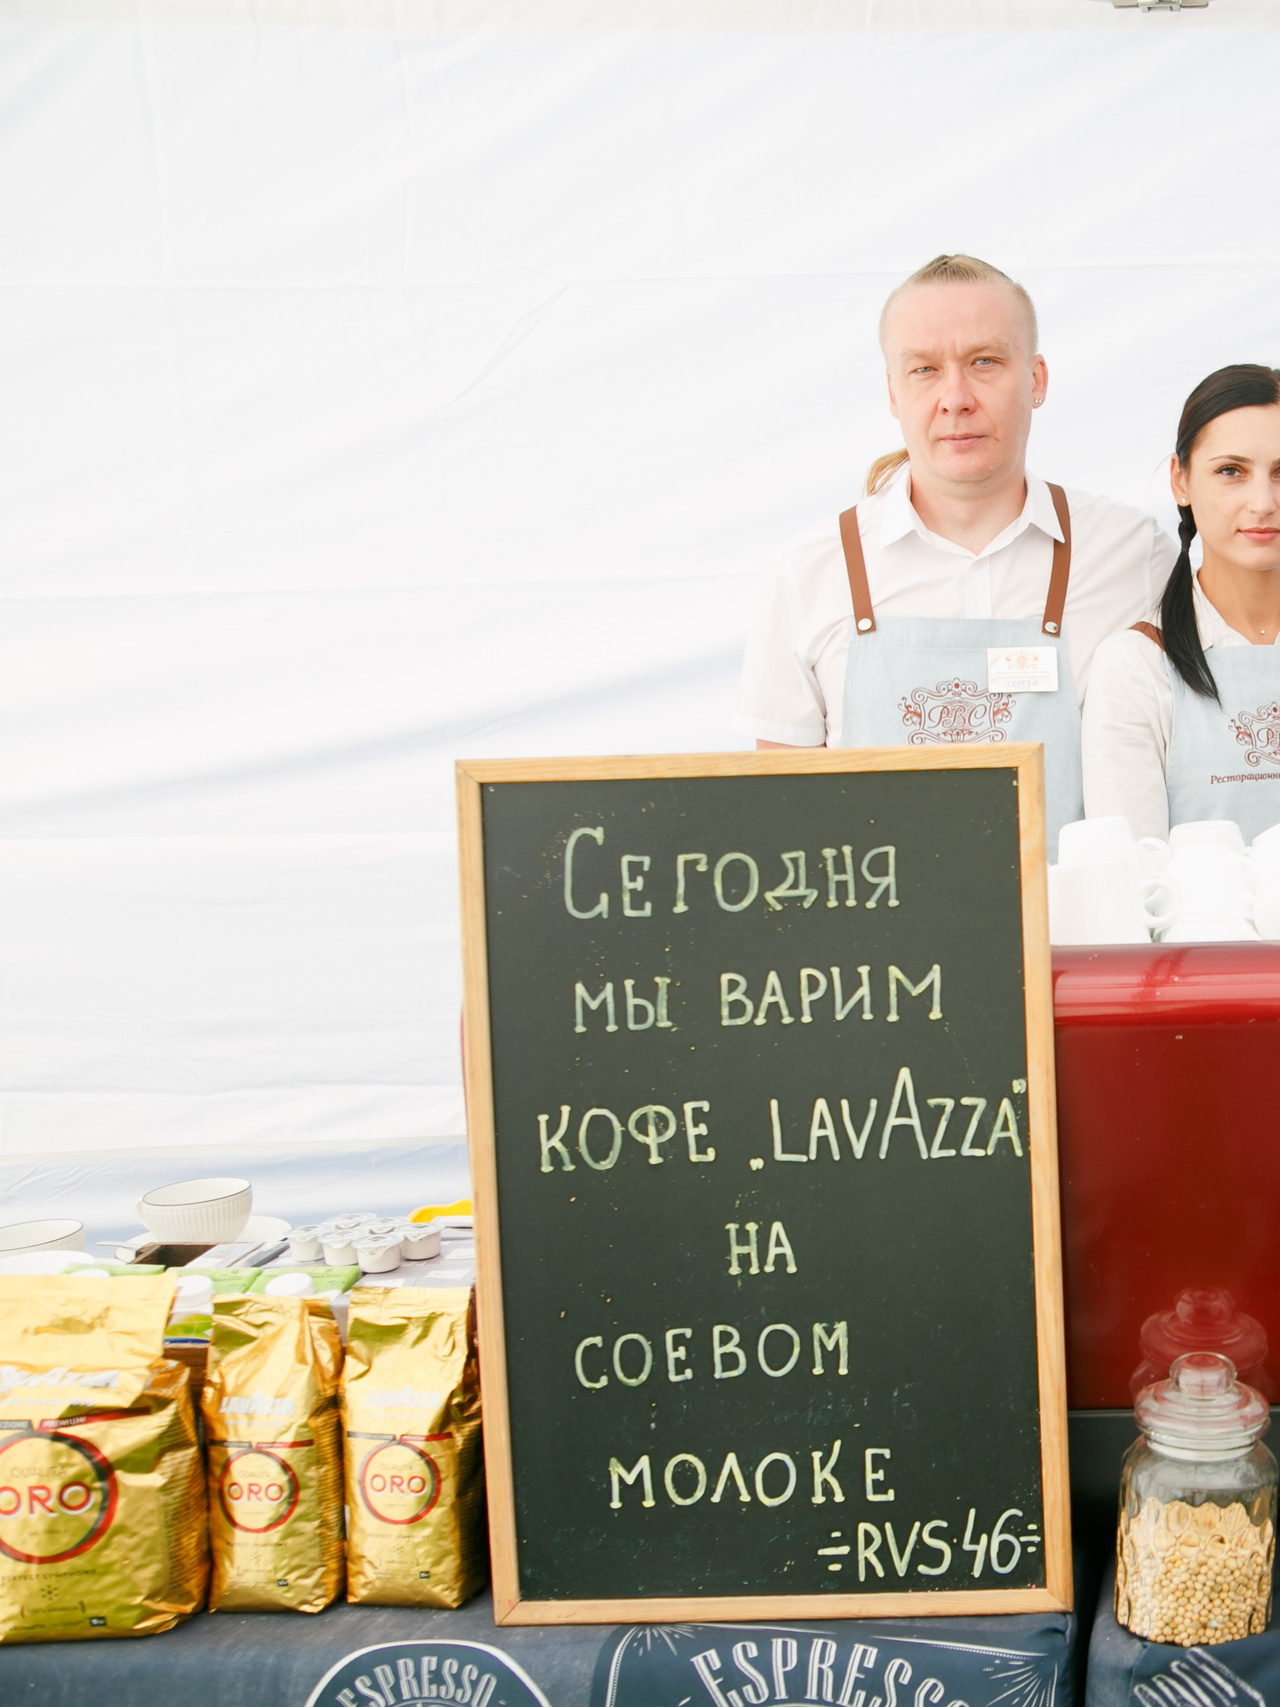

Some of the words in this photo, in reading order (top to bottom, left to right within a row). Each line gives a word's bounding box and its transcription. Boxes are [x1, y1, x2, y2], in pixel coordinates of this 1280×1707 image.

[574, 976, 673, 1033] МЫ
[720, 964, 943, 1027] ВАРИМ
[537, 1100, 716, 1172] КОФЕ
[724, 1220, 798, 1276] НА
[574, 1320, 850, 1389] СОЕВОМ
[0, 1481, 95, 1517] ORO
[227, 1481, 286, 1504] ORO
[370, 1473, 428, 1496] ORO
[610, 1439, 895, 1509] МОЛОКЕ
